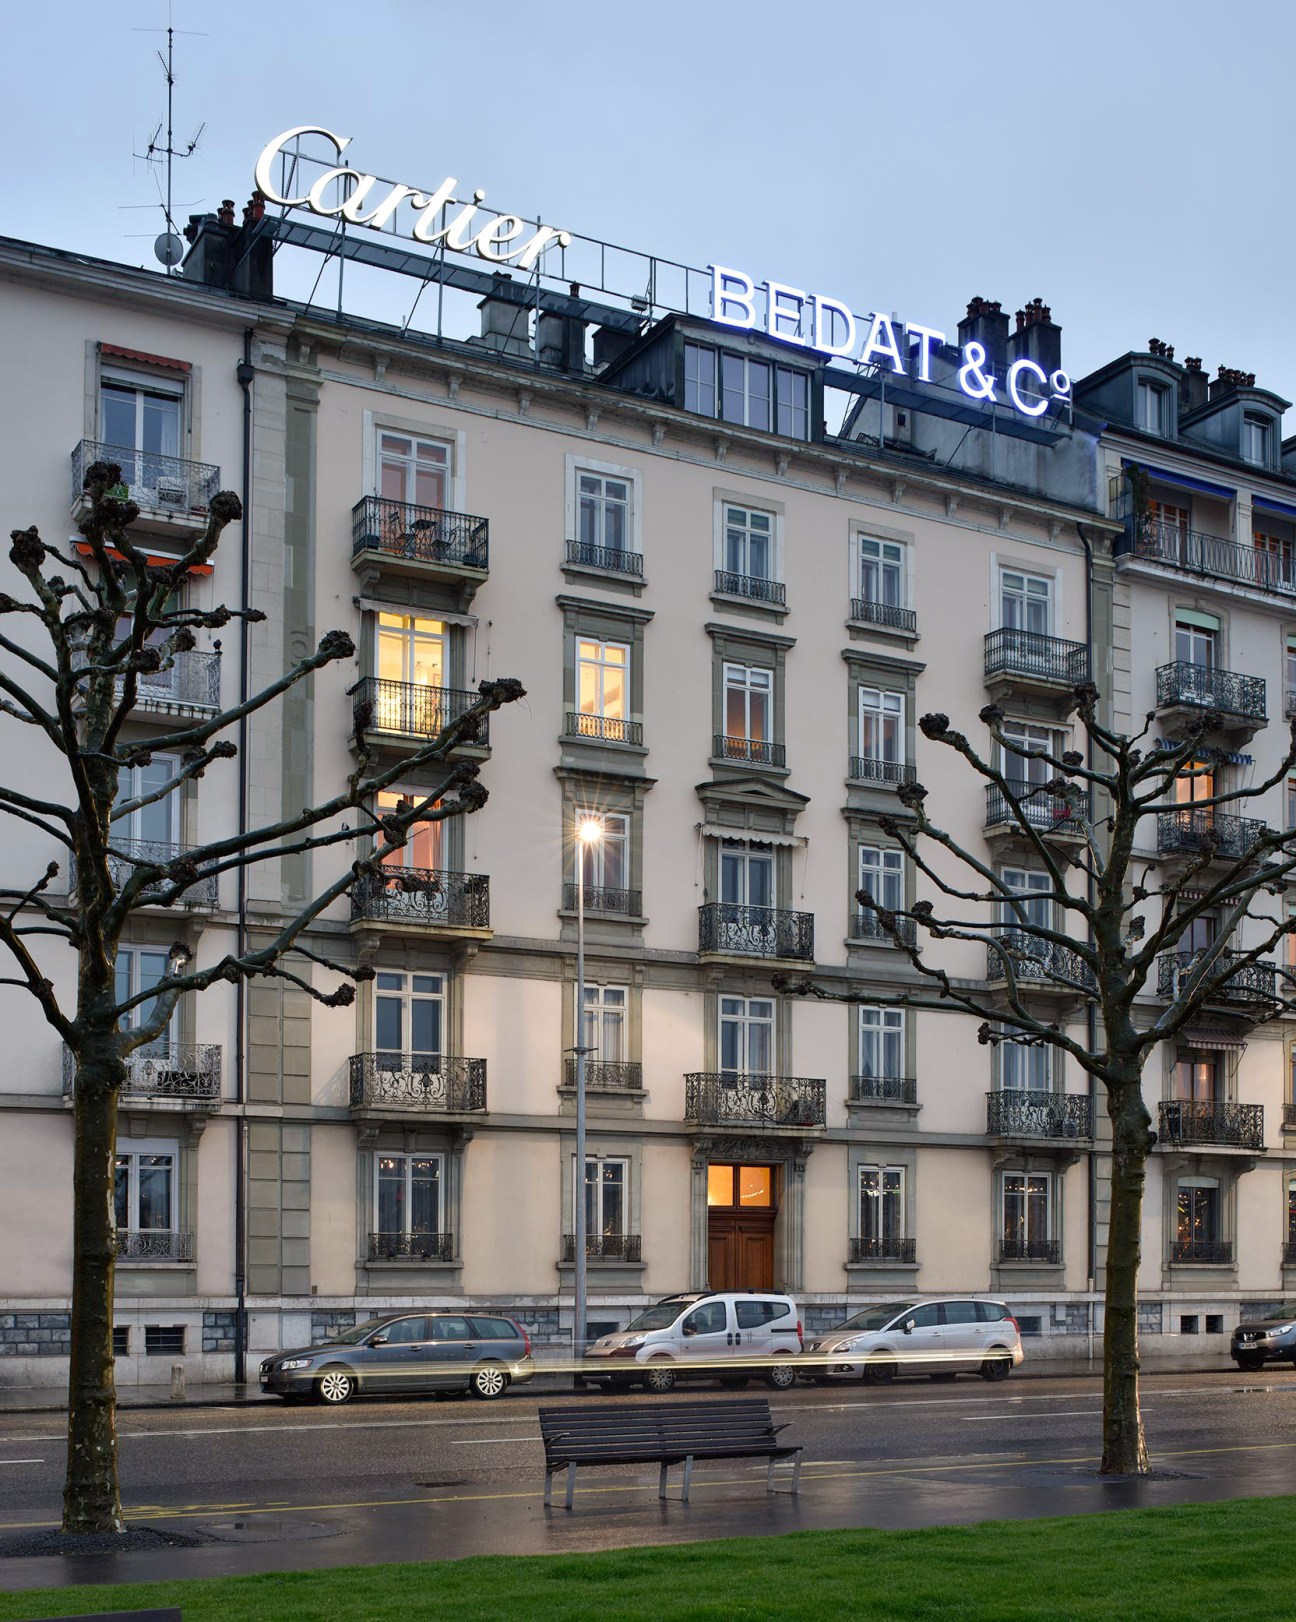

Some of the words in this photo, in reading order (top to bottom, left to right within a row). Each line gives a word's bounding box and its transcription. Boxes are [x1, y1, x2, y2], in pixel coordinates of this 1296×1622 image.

[254, 125, 572, 269] Cartier
[707, 264, 945, 382] BEDAT
[957, 341, 997, 402] &
